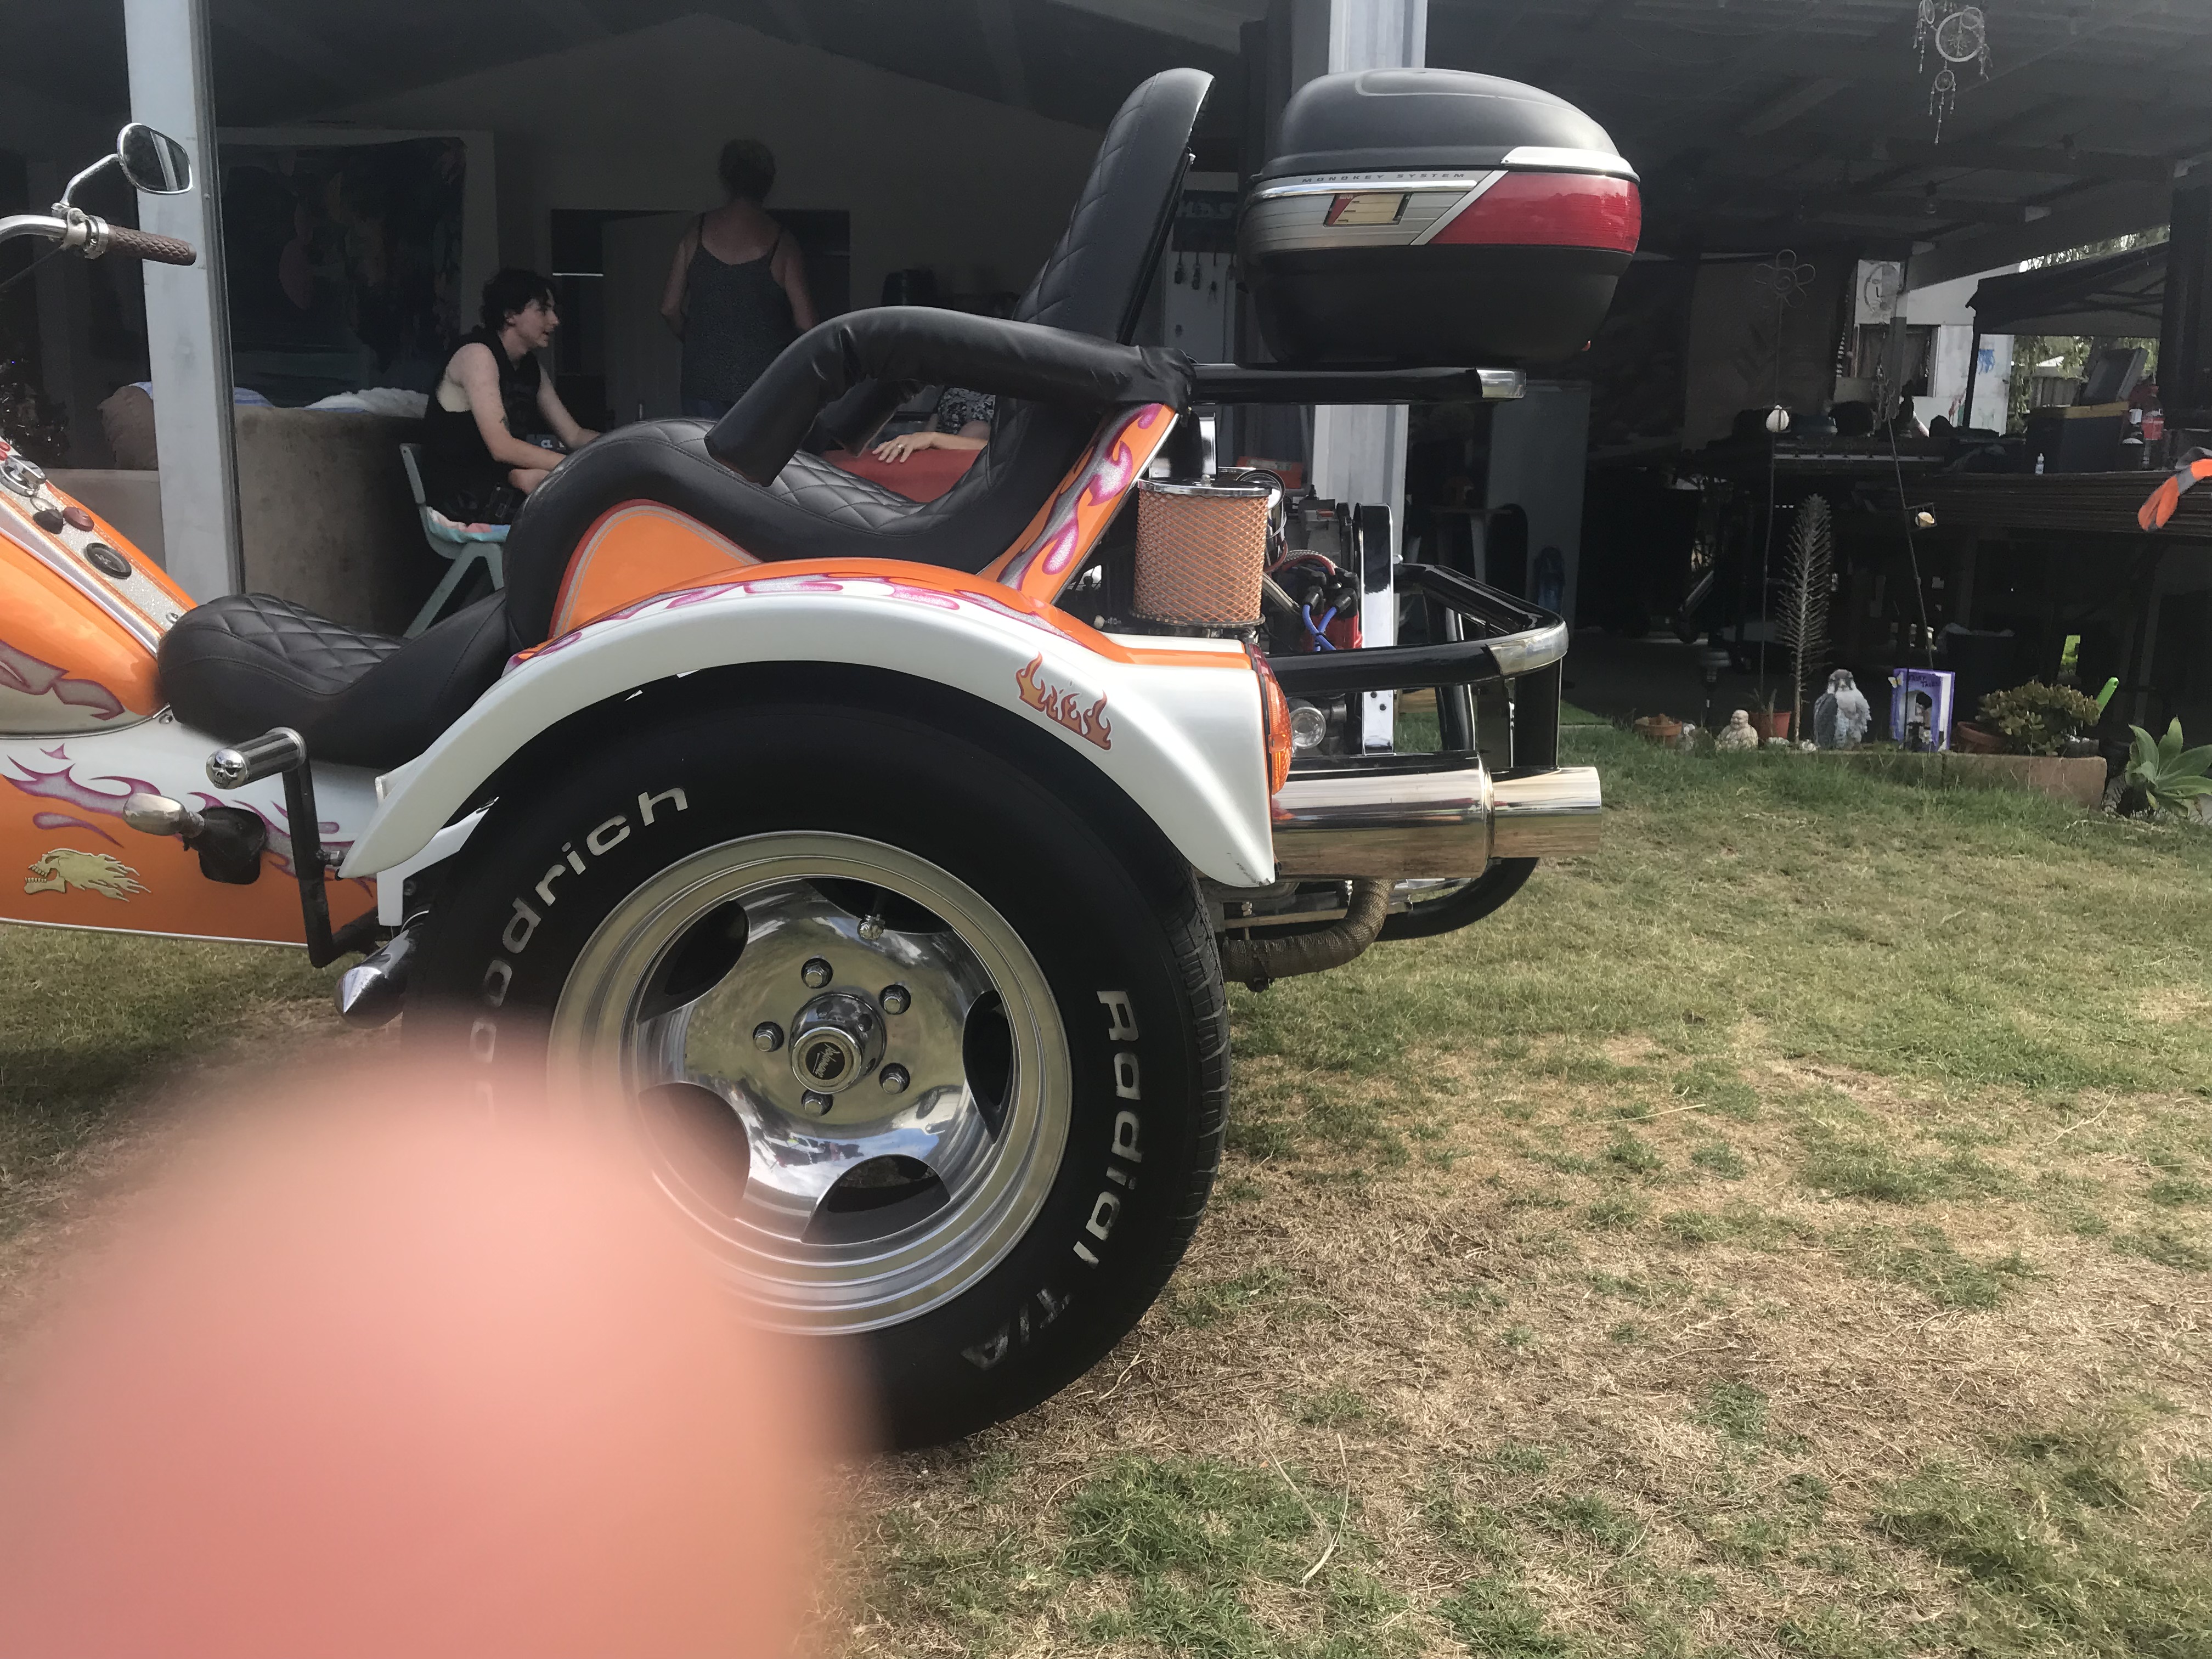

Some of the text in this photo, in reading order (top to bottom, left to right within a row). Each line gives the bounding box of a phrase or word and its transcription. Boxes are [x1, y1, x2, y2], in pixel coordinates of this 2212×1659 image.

[1302, 174, 1385, 183] MONOKEY
[469, 786, 689, 1116] oodrich
[1073, 990, 1145, 1269] Radial
[961, 1288, 1073, 1371] T/A
